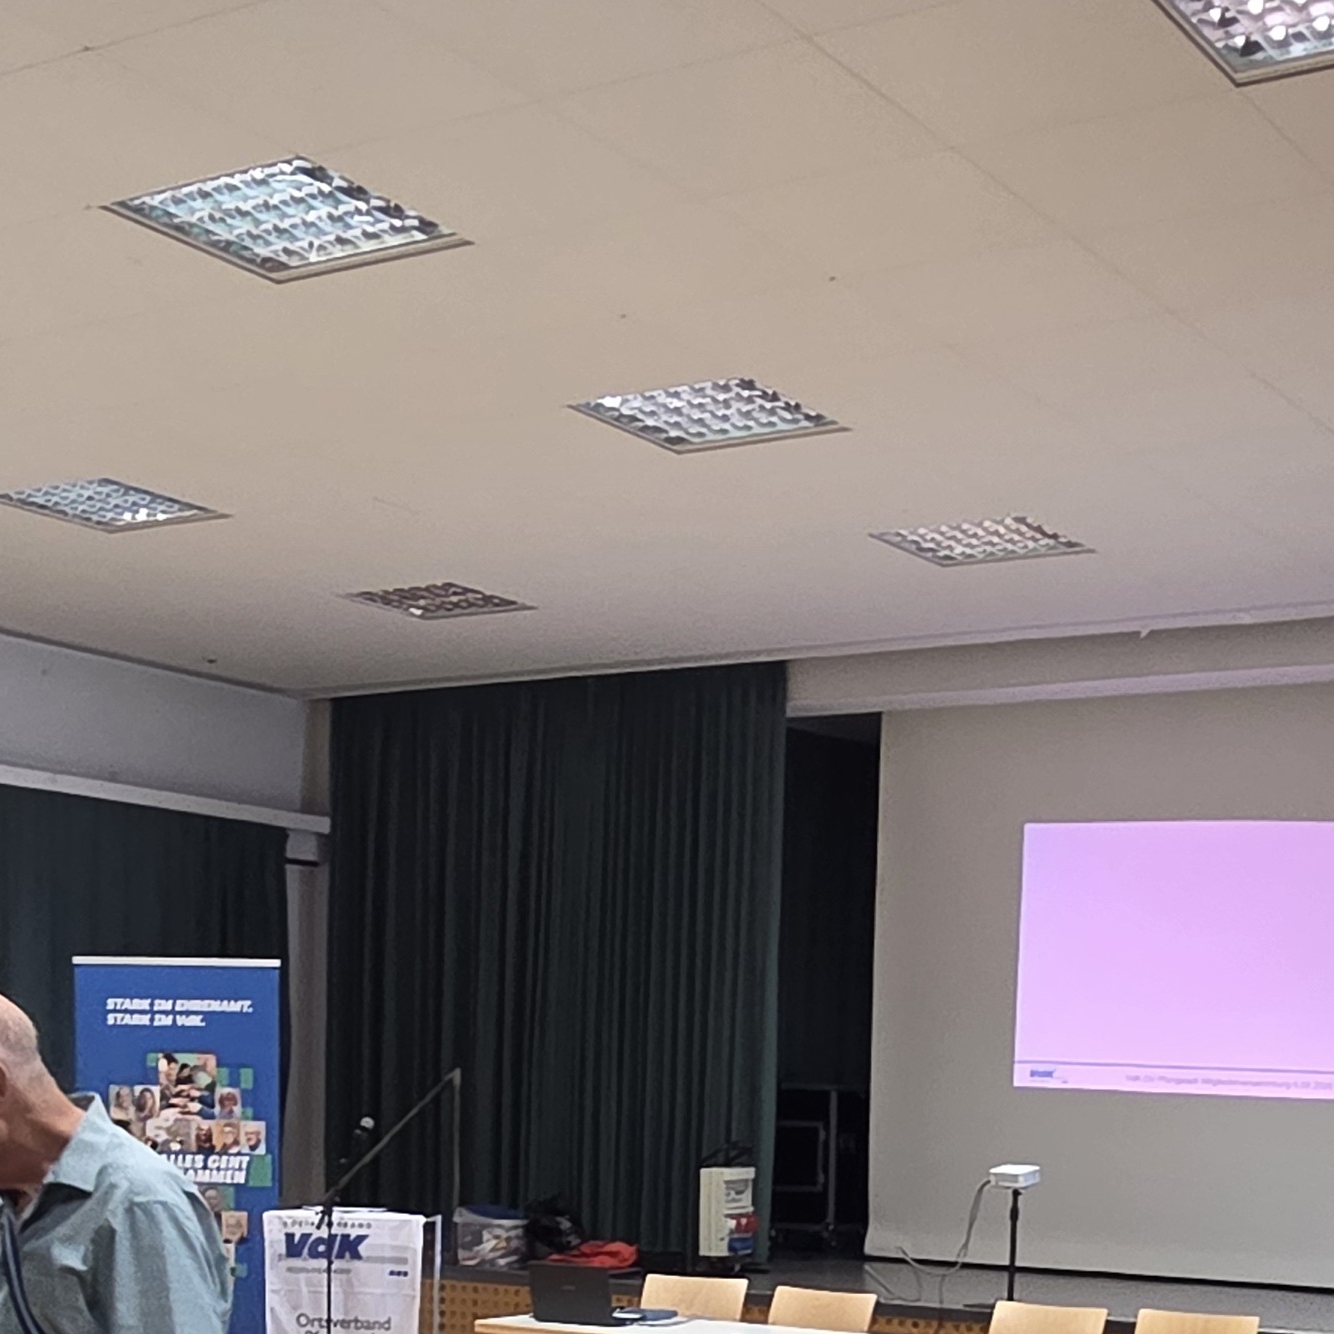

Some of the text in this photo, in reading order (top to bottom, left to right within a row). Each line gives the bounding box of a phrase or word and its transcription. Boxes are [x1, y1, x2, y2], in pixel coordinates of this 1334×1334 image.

[106, 998, 151, 1010] STARK
[106, 1013, 151, 1025] STARK
[161, 1154, 205, 1169] LLES
[284, 1232, 370, 1260] VdK
